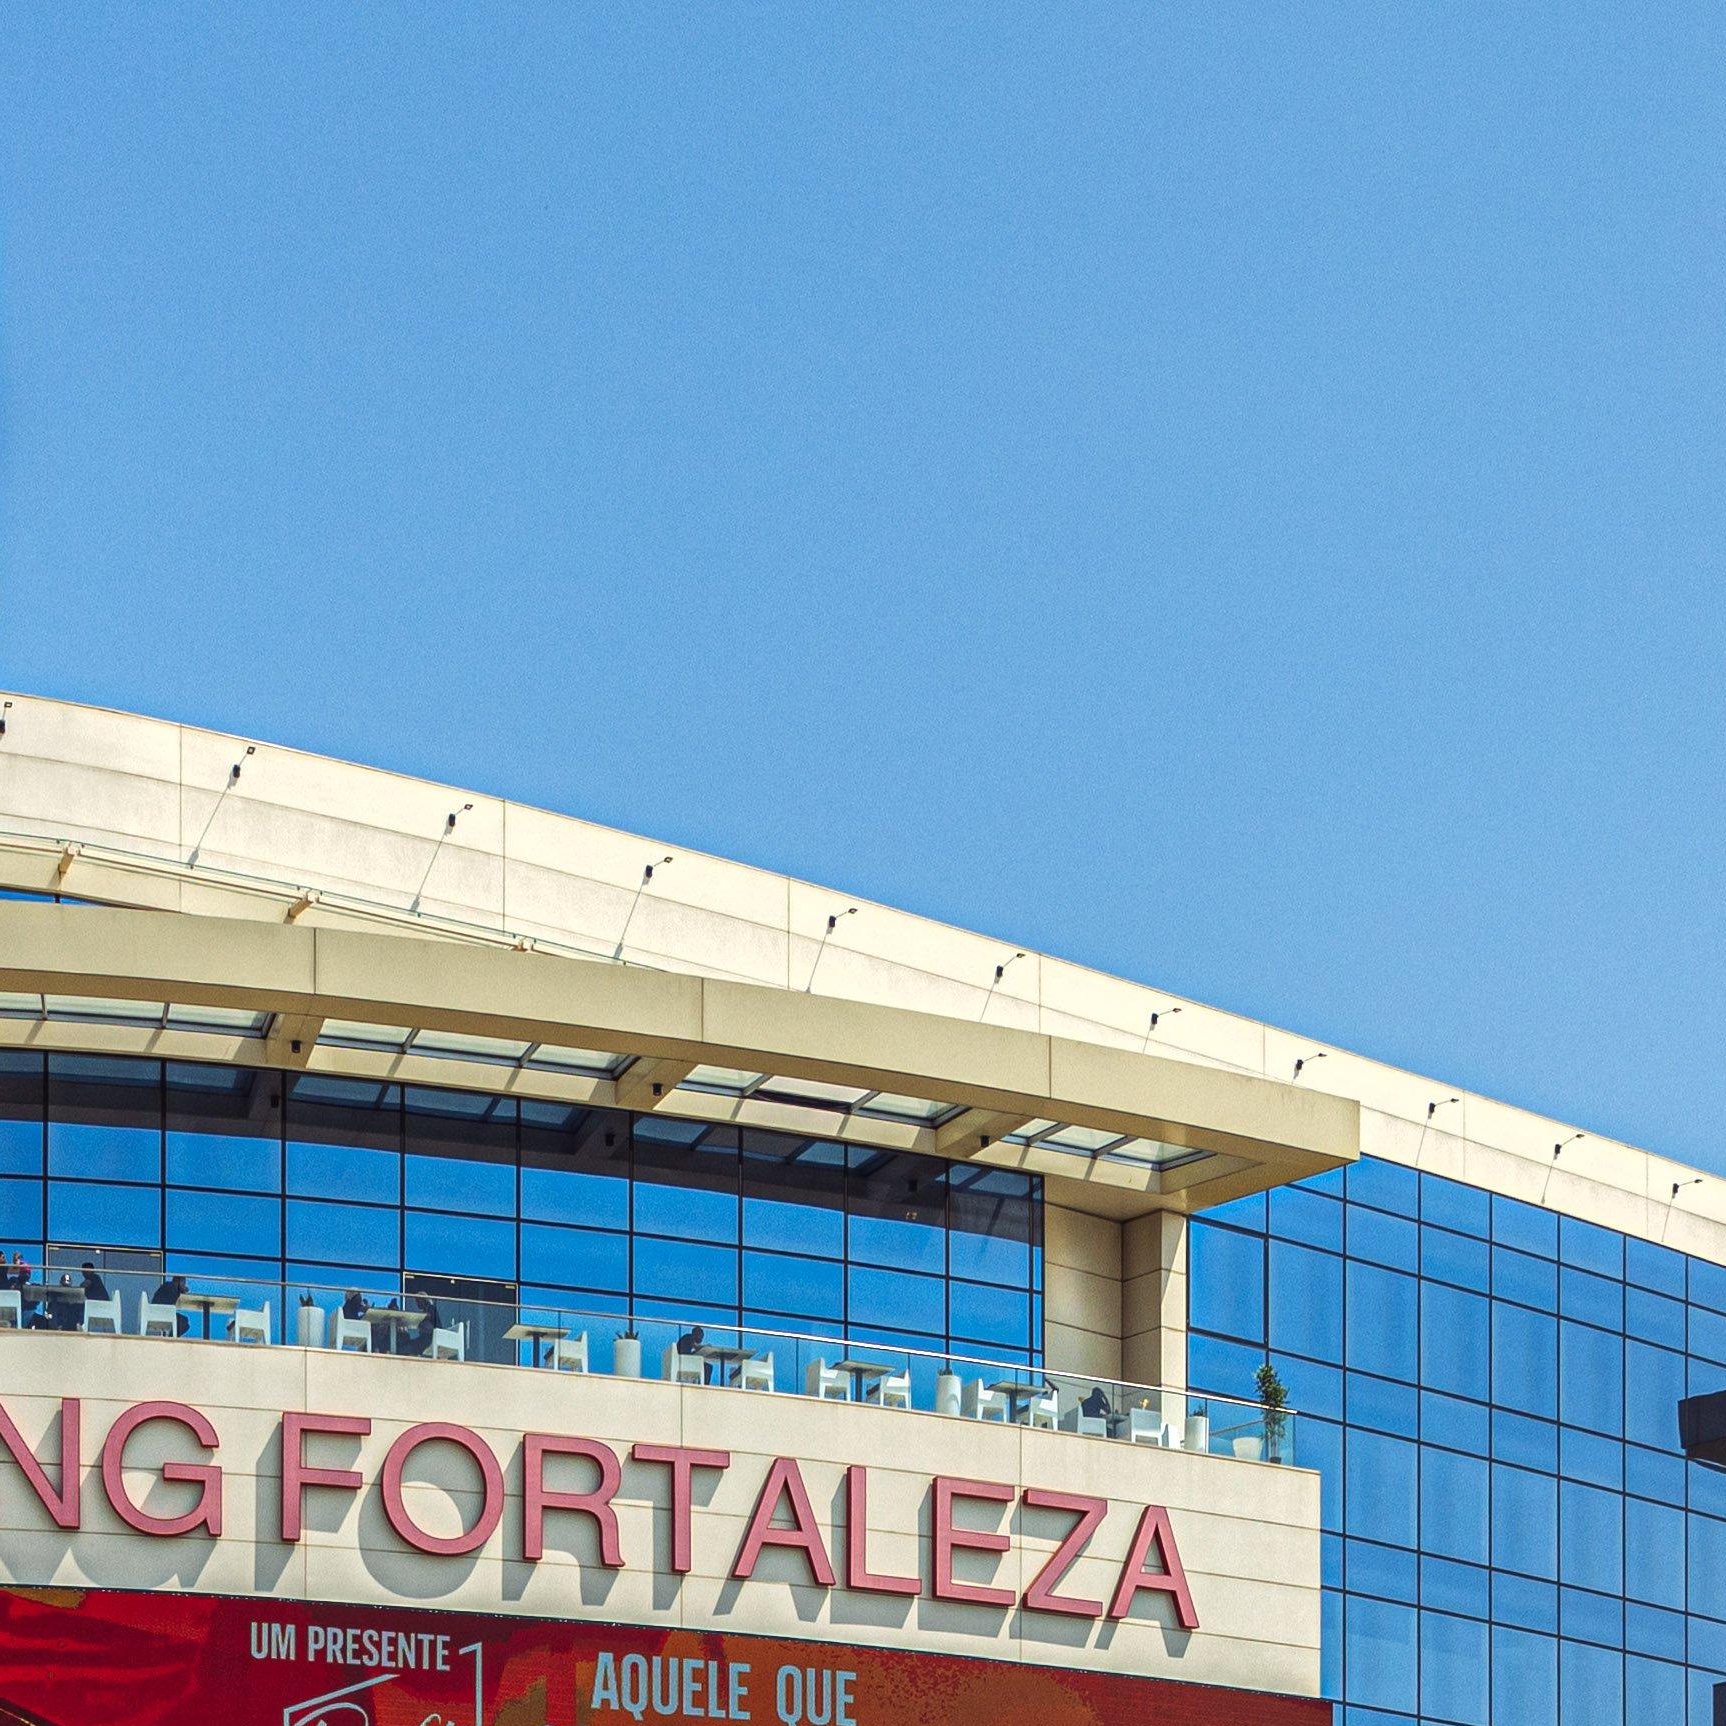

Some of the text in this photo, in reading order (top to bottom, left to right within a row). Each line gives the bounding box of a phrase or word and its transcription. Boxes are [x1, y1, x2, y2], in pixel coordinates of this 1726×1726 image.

[281, 1411, 1200, 1630] FORTALEZA
[250, 1622, 451, 1671] UM PRESENTE
[591, 1652, 752, 1721] AQUELE
